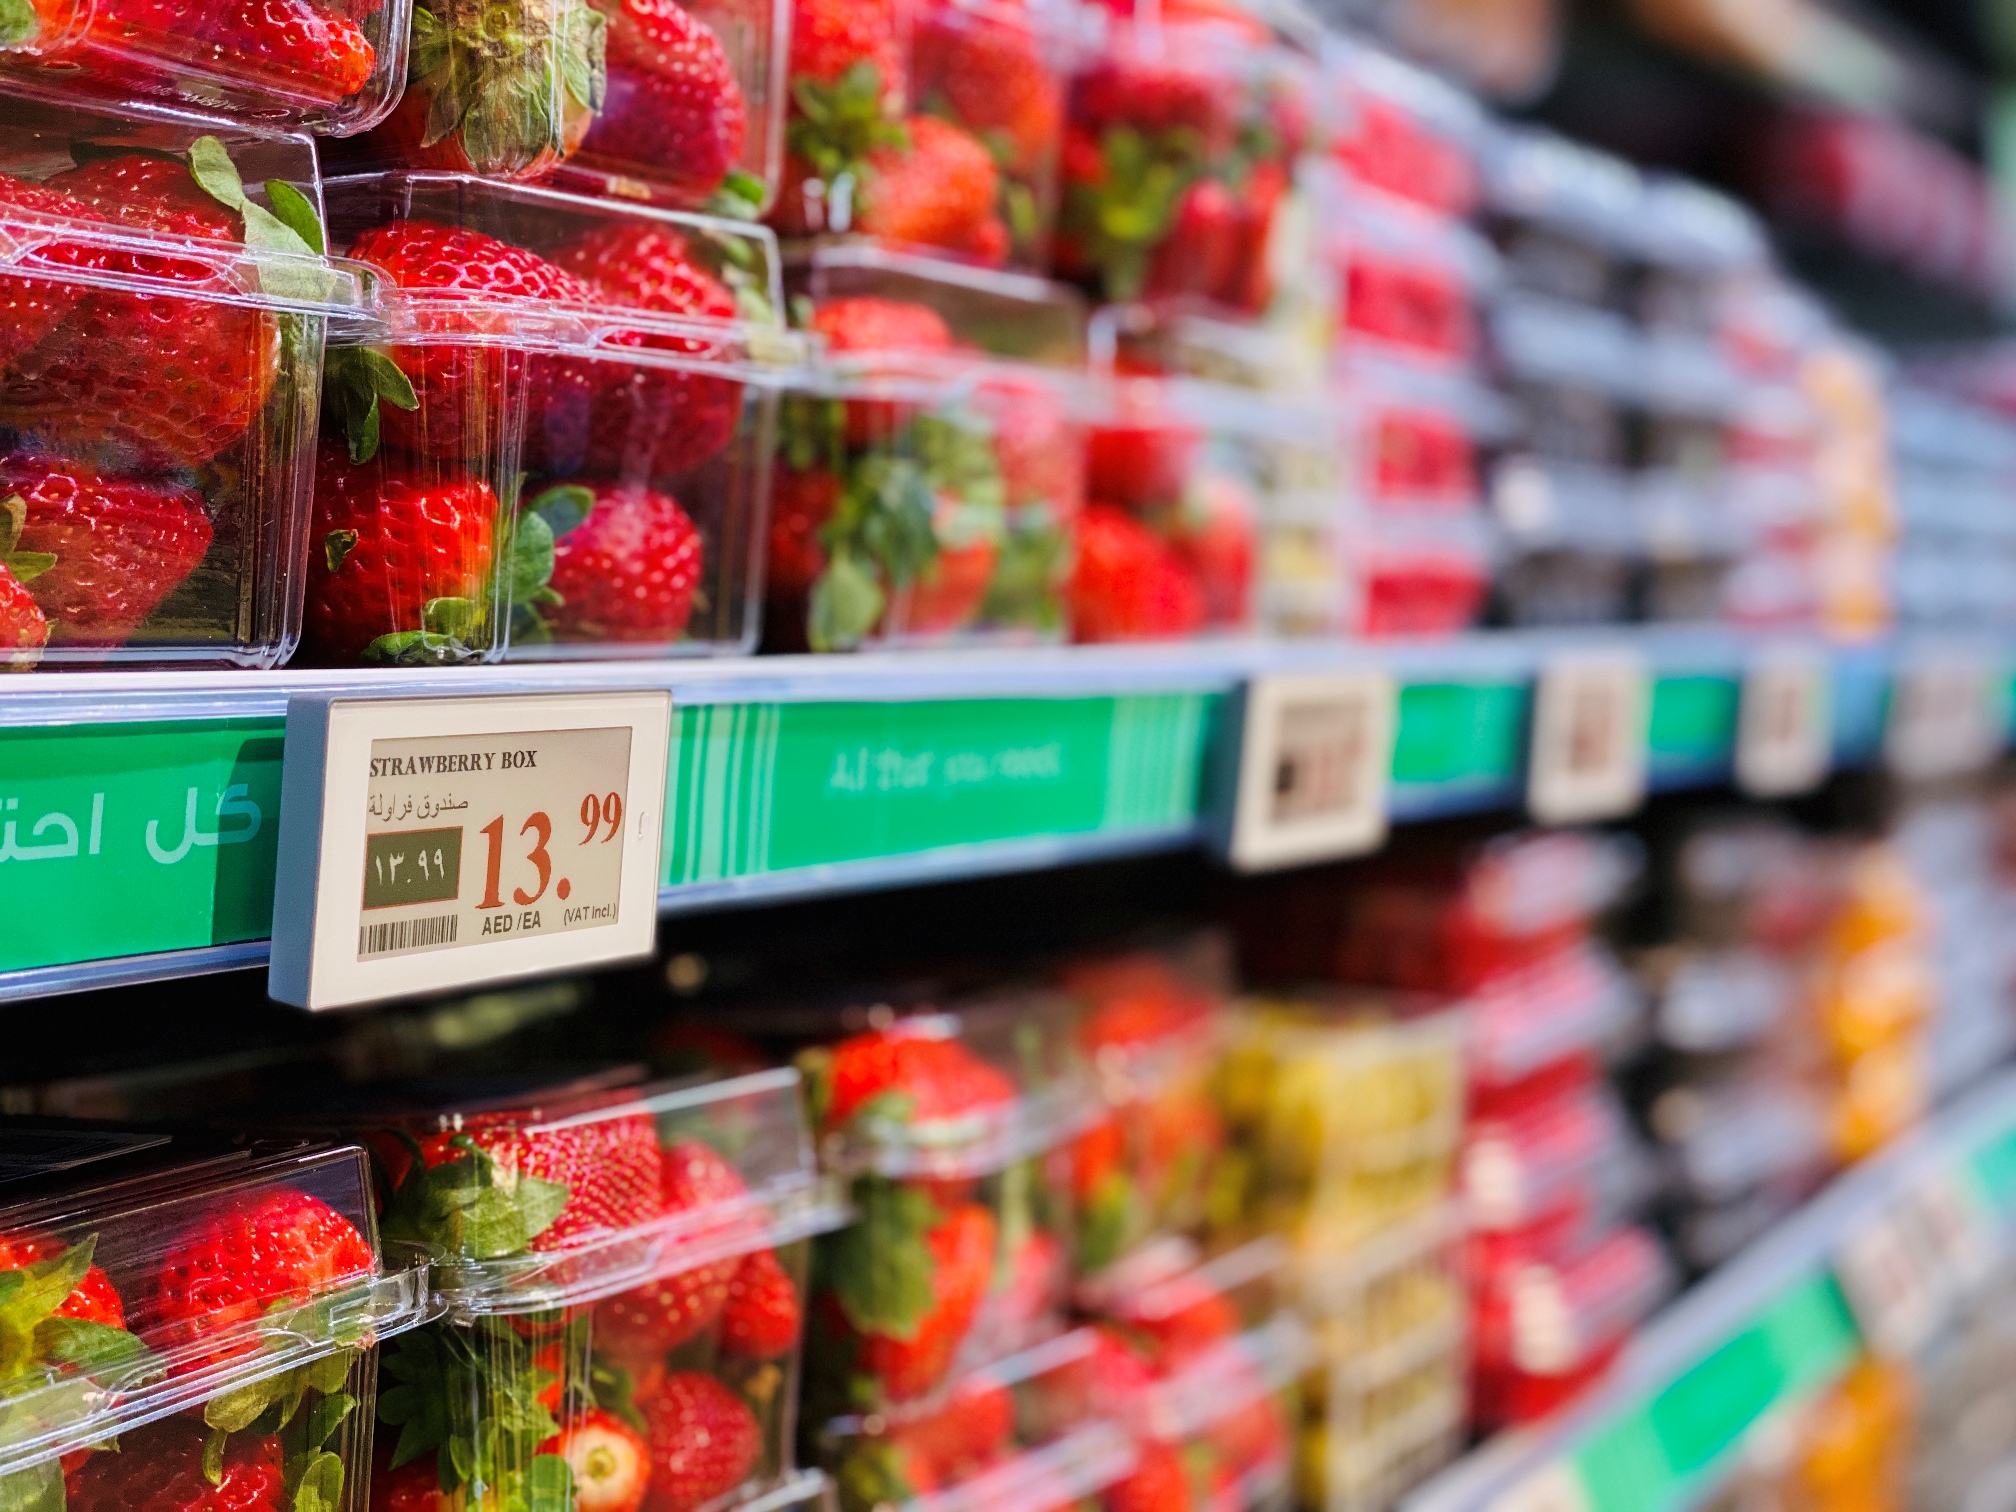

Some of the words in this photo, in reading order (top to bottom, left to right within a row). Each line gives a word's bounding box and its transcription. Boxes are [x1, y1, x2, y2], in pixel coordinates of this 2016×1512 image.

[369, 752, 496, 777] STRAWBERRY
[500, 750, 538, 769] BOX
[368, 793, 412, 822] فراولة
[417, 793, 468, 819] صندوق
[145, 783, 262, 865] كل
[563, 906, 590, 927] (VAT
[591, 902, 617, 920] Incl.)
